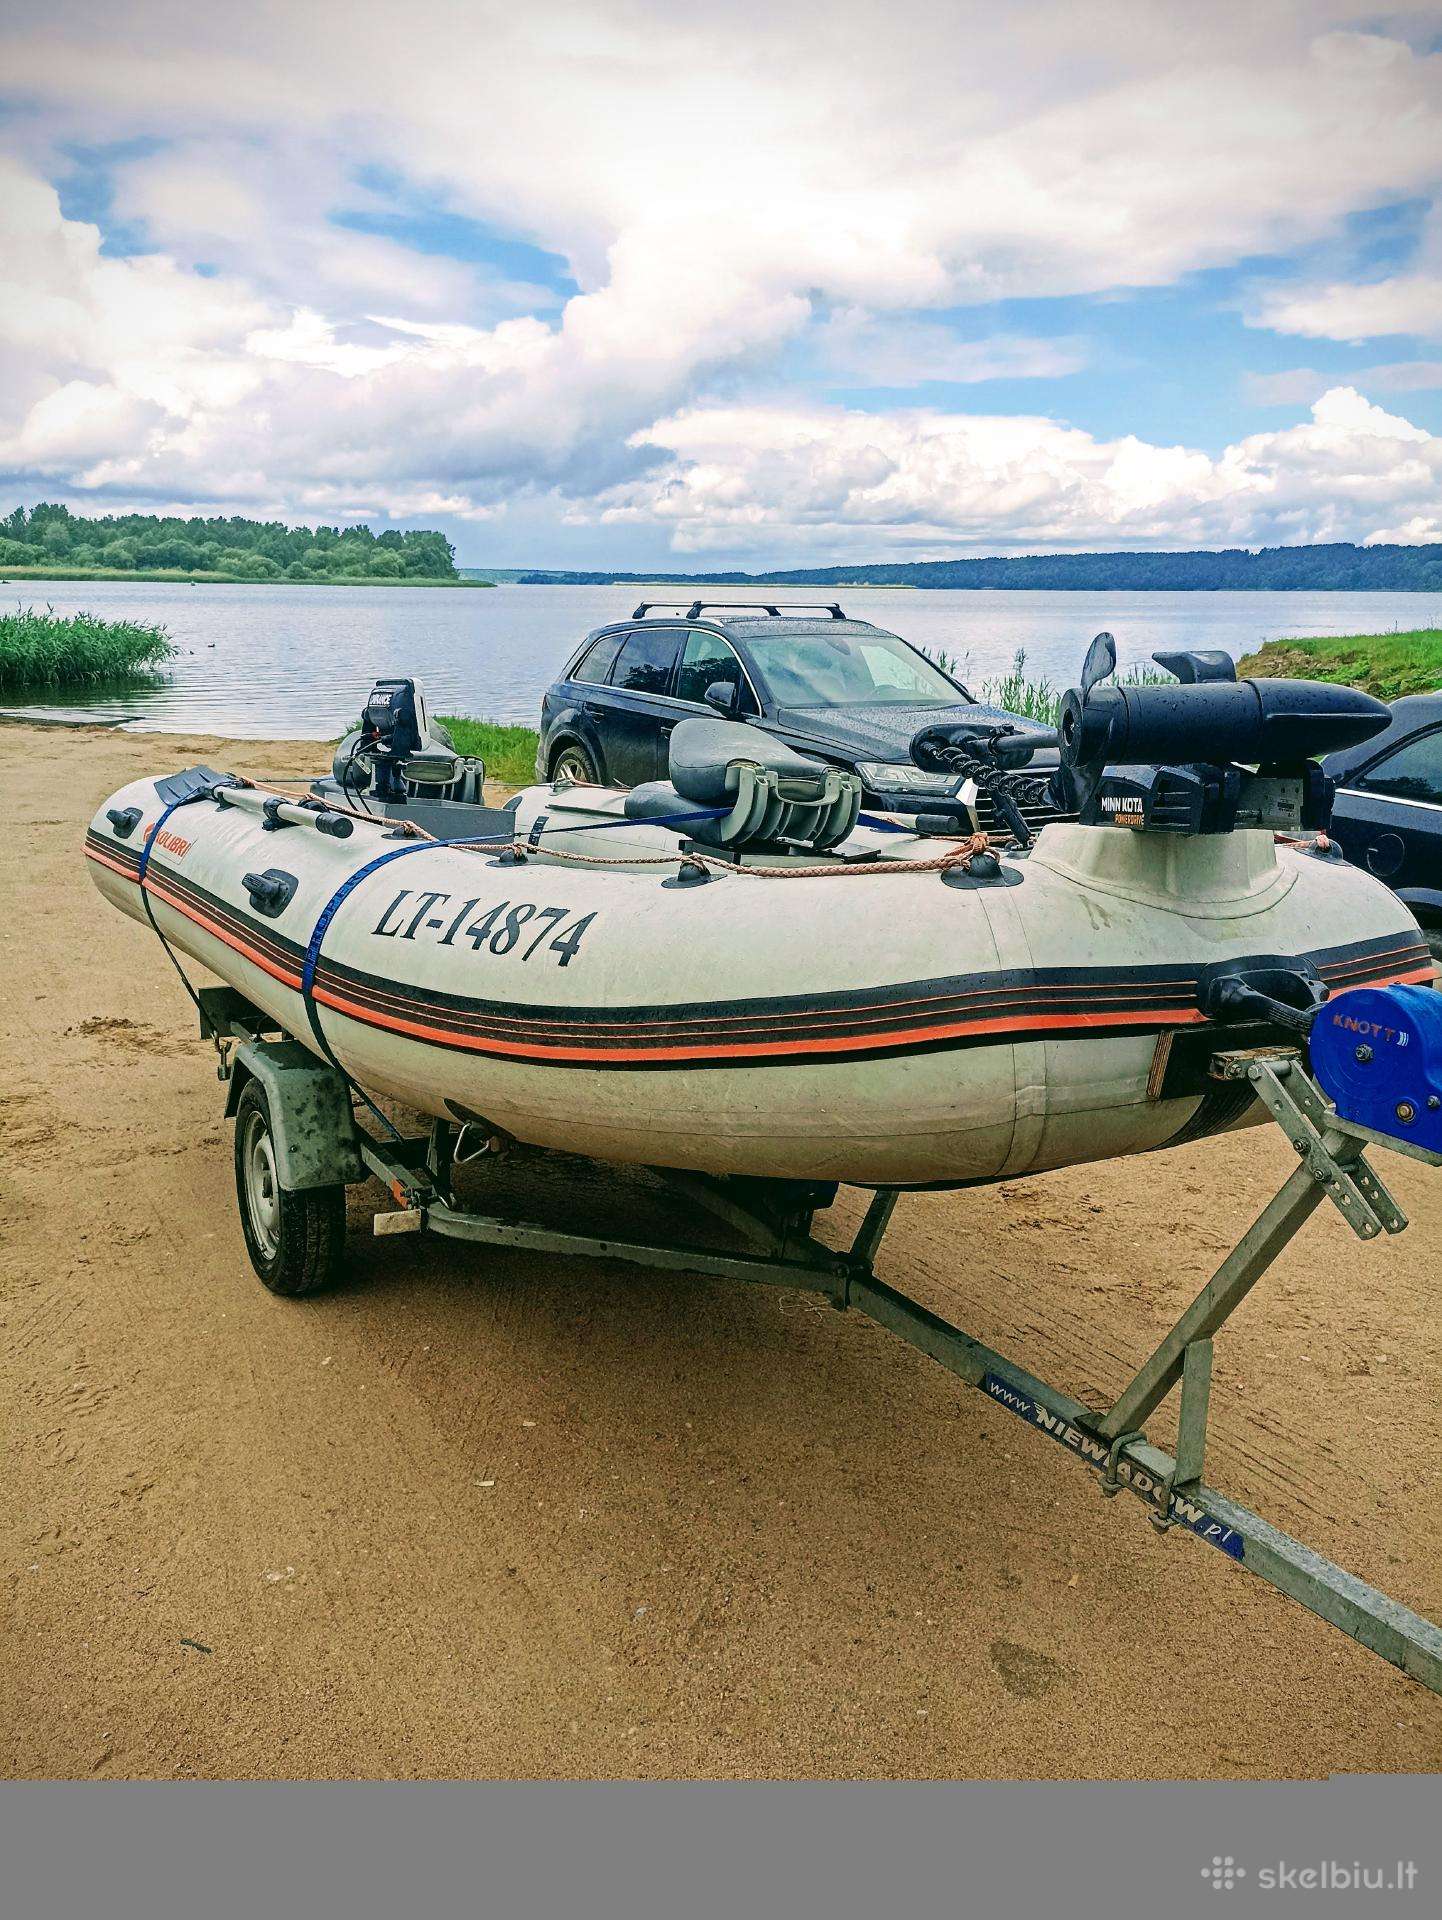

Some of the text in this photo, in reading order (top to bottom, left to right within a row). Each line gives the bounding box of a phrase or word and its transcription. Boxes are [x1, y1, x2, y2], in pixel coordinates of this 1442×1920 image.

[1101, 797, 1143, 813] MINN KOTA
[370, 889, 598, 967] LT-14874
[1332, 1013, 1396, 1042] KNOTT
